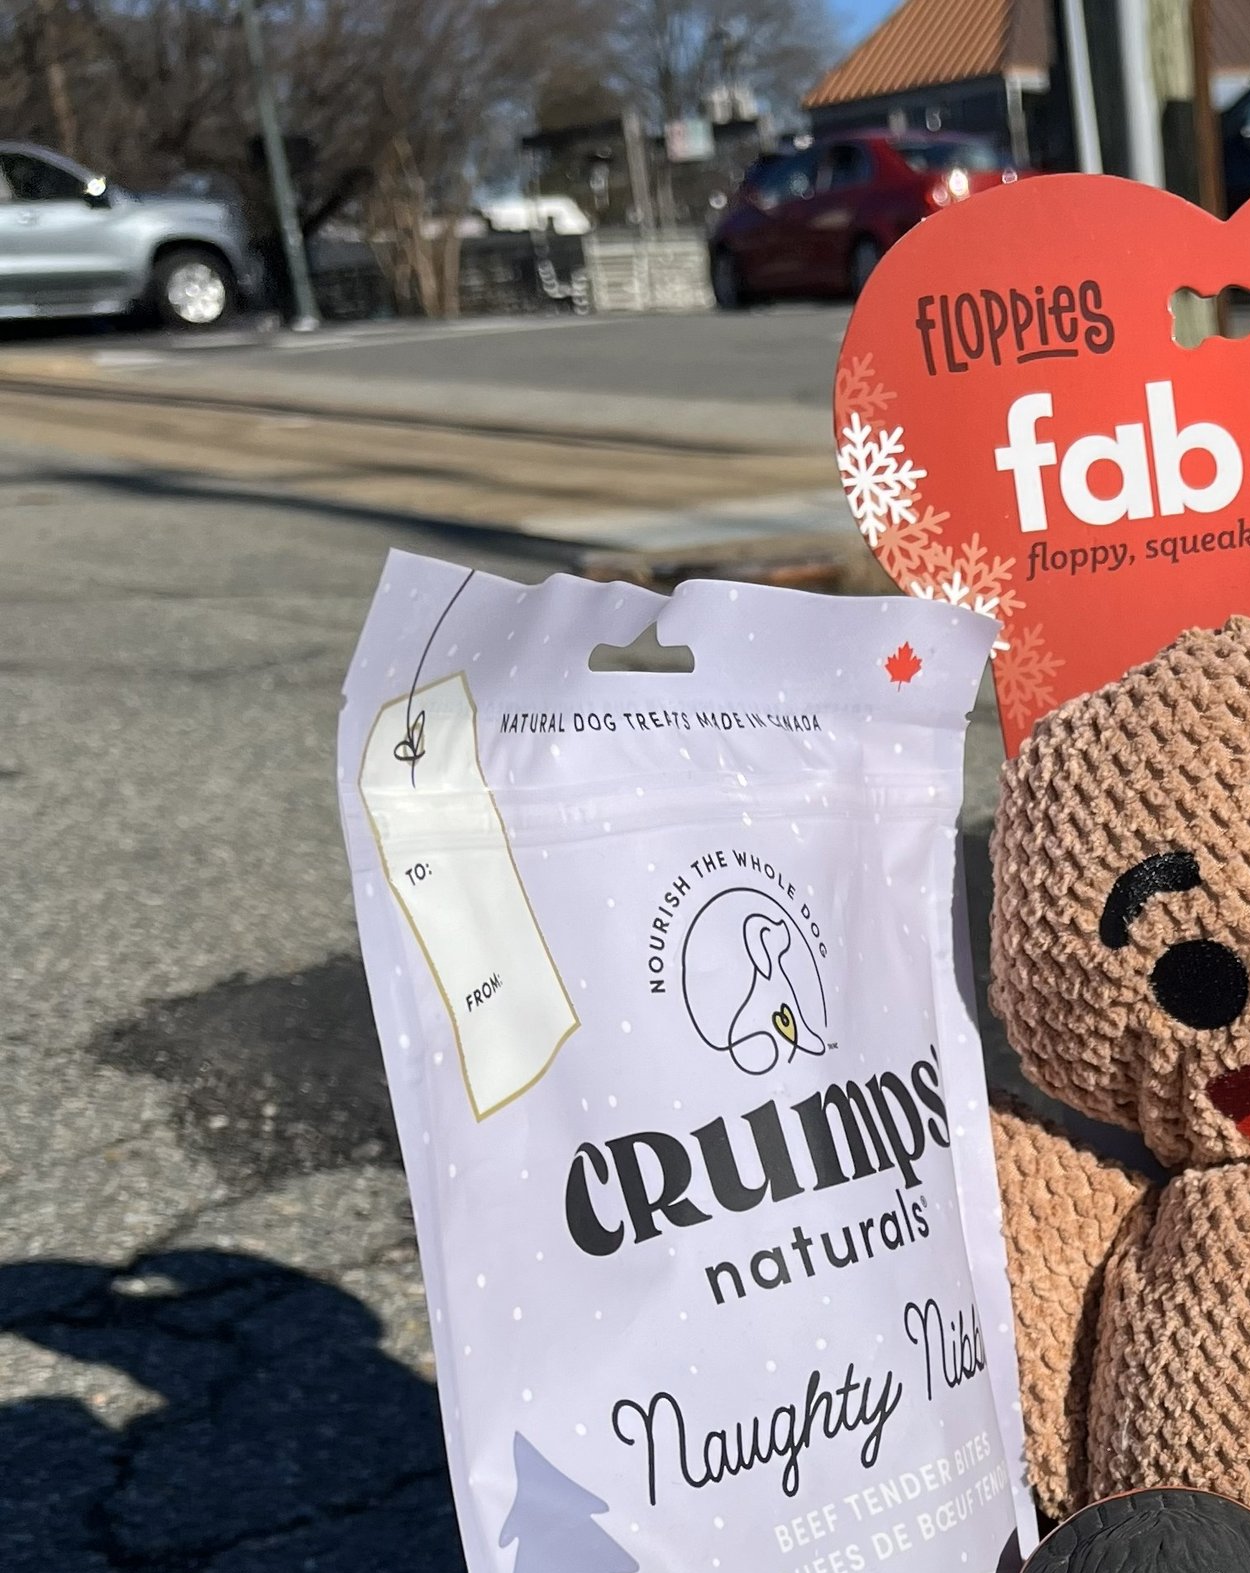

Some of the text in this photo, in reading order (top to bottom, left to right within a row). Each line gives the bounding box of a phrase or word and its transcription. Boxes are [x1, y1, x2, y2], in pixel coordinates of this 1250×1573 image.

[1026, 541, 1136, 580] floppy,
[500, 713, 565, 733] NATURAL
[573, 713, 616, 732] DOG
[623, 710, 690, 731] TREATS
[696, 712, 745, 730] MADE
[749, 713, 766, 728] IN
[405, 863, 432, 886] TO:
[648, 849, 827, 993] NOURISH THE WHOLE DOG
[465, 972, 503, 1013] FROM:
[705, 1188, 930, 1305] naturals
[612, 1298, 987, 1506] Naughty Nibb
[774, 1431, 991, 1554] BEEF TENDER BITES
[870, 1523, 912, 1560] DE
[975, 1461, 1008, 1507] TEND
